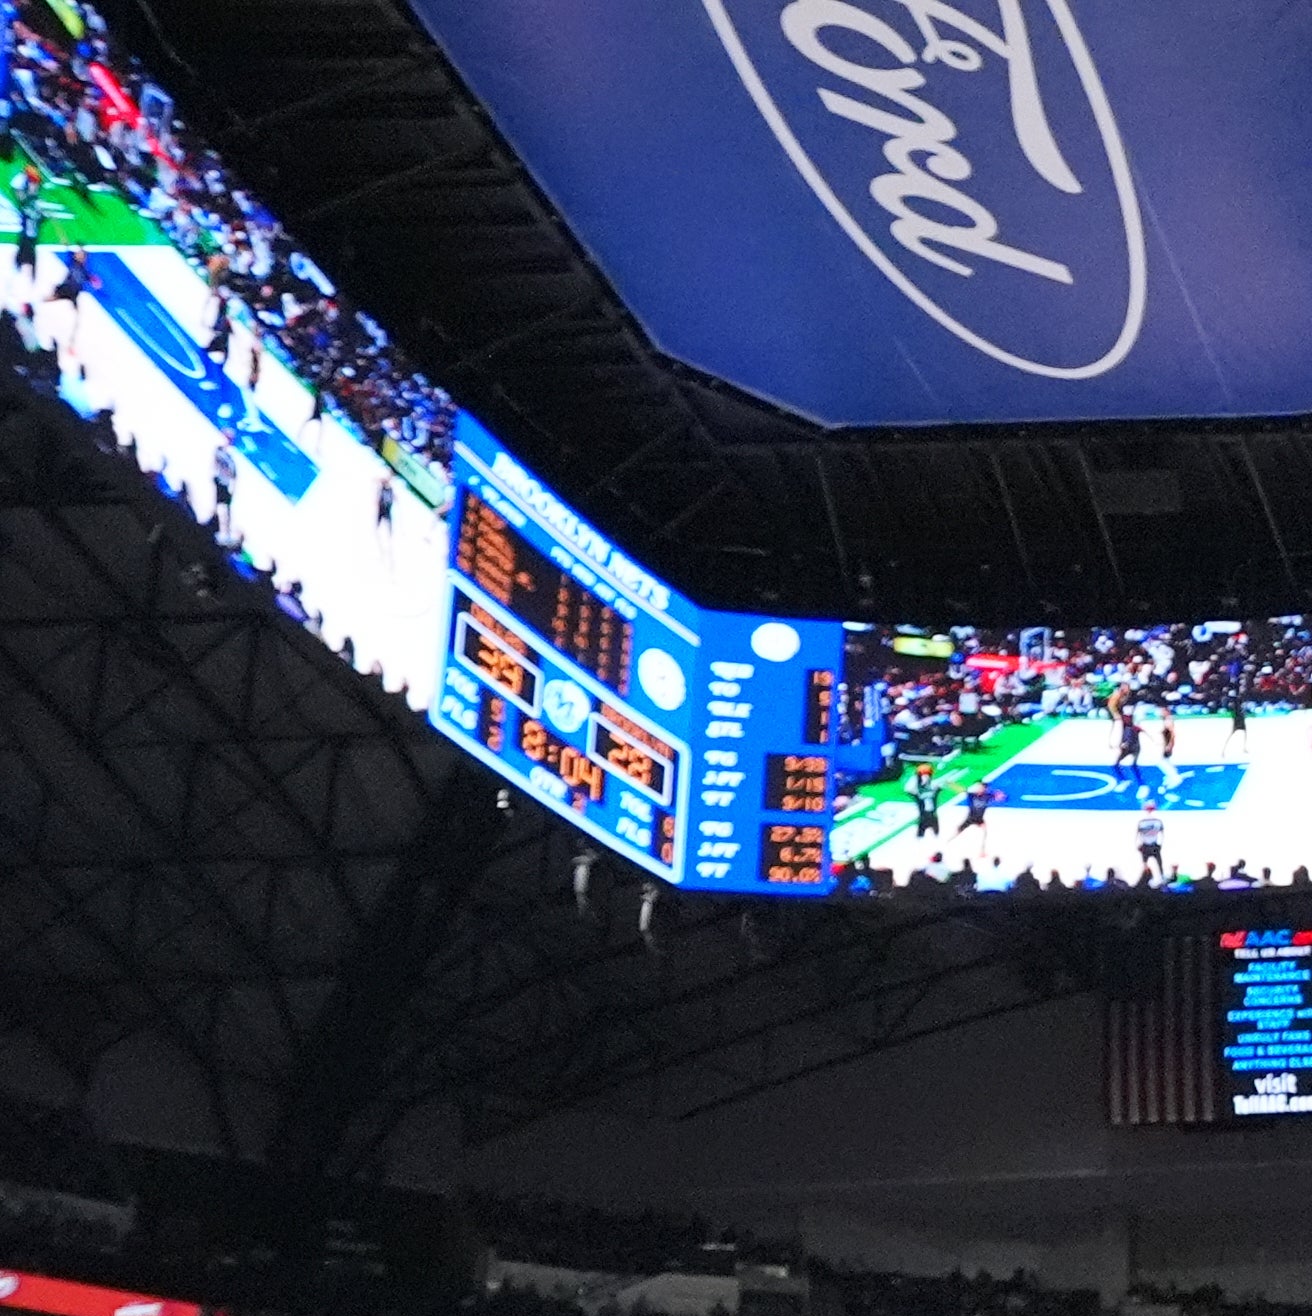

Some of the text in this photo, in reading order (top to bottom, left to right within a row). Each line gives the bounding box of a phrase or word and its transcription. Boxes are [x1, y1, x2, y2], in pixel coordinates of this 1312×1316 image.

[780, 0, 1083, 284] Ford
[607, 551, 670, 611] NETS
[522, 720, 604, 801] 8:04
[1245, 929, 1291, 947] AAC
[1227, 1008, 1294, 1022] EXPERIENCE
[1254, 1073, 1298, 1094] visit
